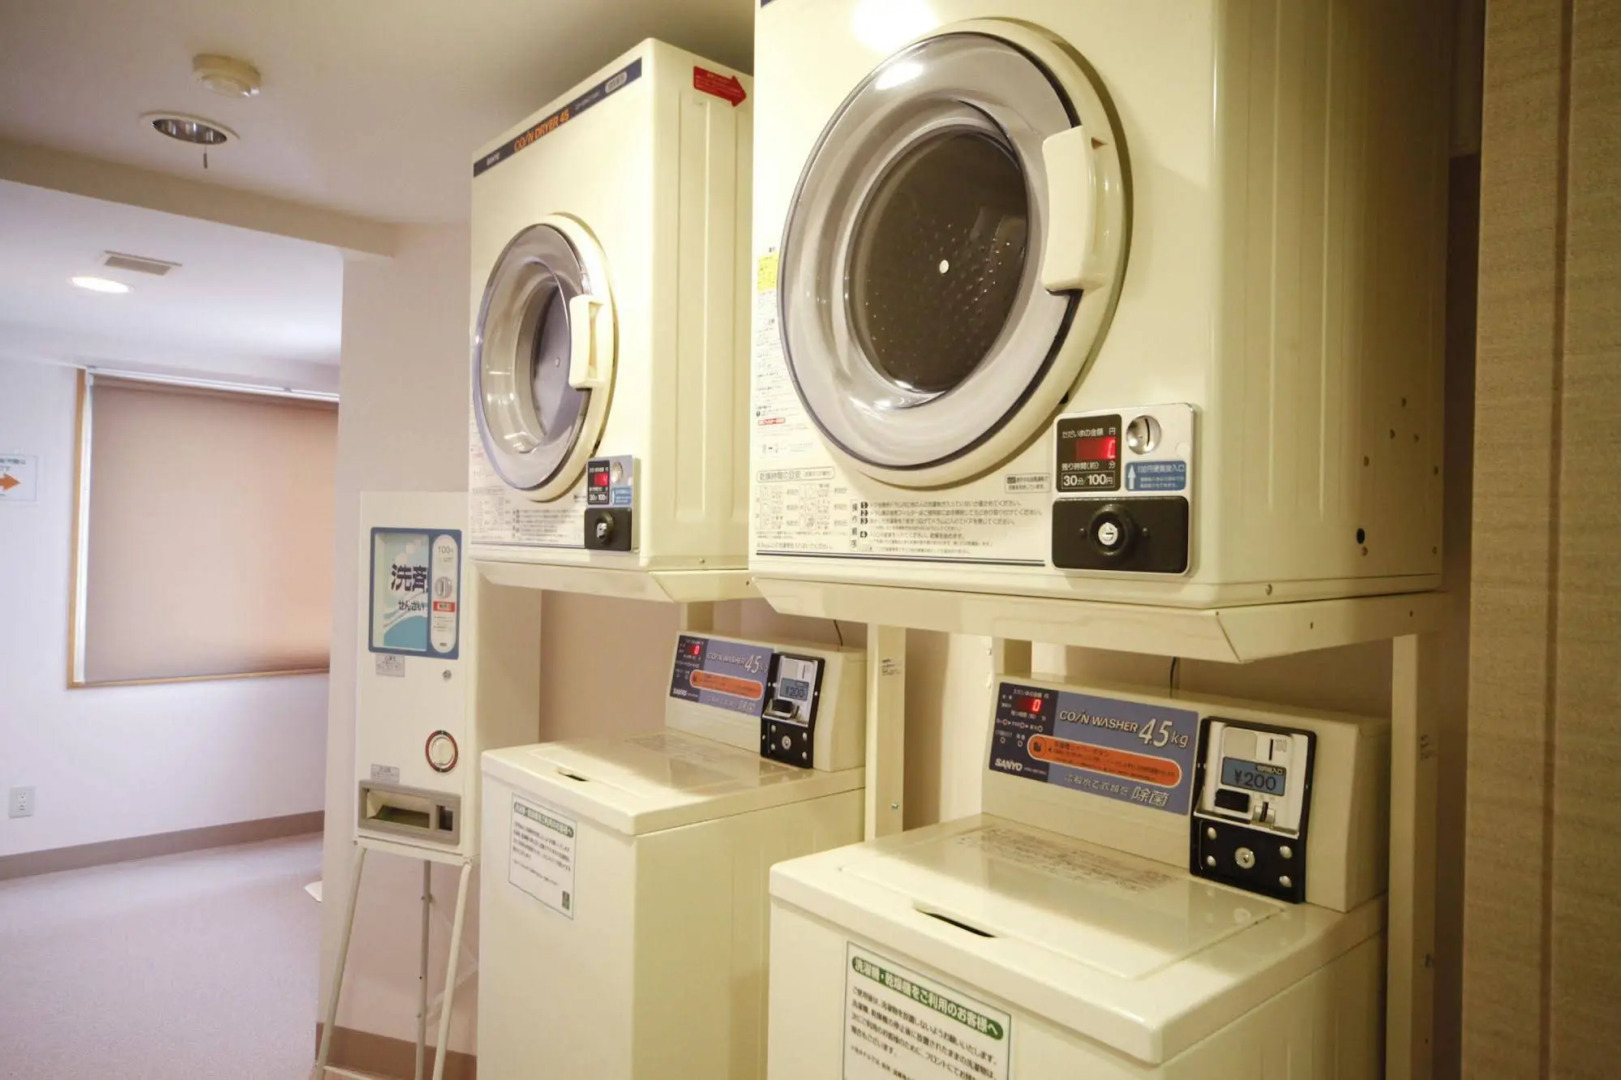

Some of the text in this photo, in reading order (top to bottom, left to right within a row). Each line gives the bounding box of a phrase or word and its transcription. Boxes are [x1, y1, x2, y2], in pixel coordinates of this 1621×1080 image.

[1031, 699, 1042, 712] 0
[1092, 716, 1139, 733] WASHER
[995, 757, 1023, 772] SANYO
[1234, 768, 1277, 791] ¥200
